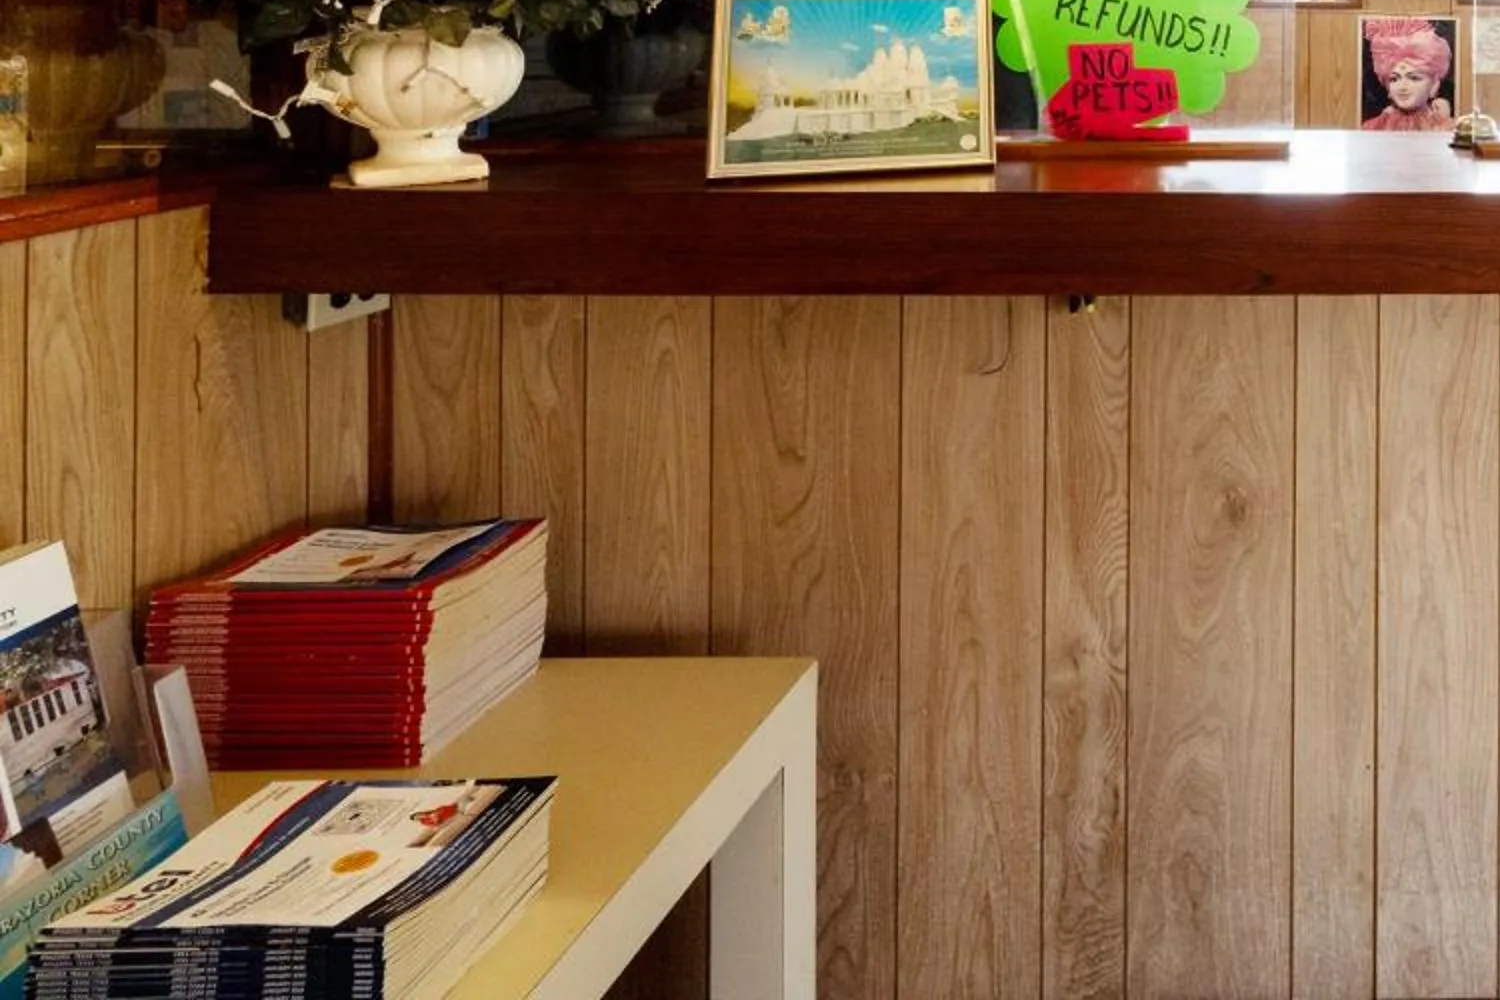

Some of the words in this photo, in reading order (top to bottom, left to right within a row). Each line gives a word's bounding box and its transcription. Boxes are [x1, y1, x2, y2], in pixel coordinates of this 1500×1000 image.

[1081, 48, 1129, 81] NO
[0, 869, 84, 936] RAZORIA
[88, 803, 166, 871] COUNTY
[51, 858, 132, 922] CORNER
